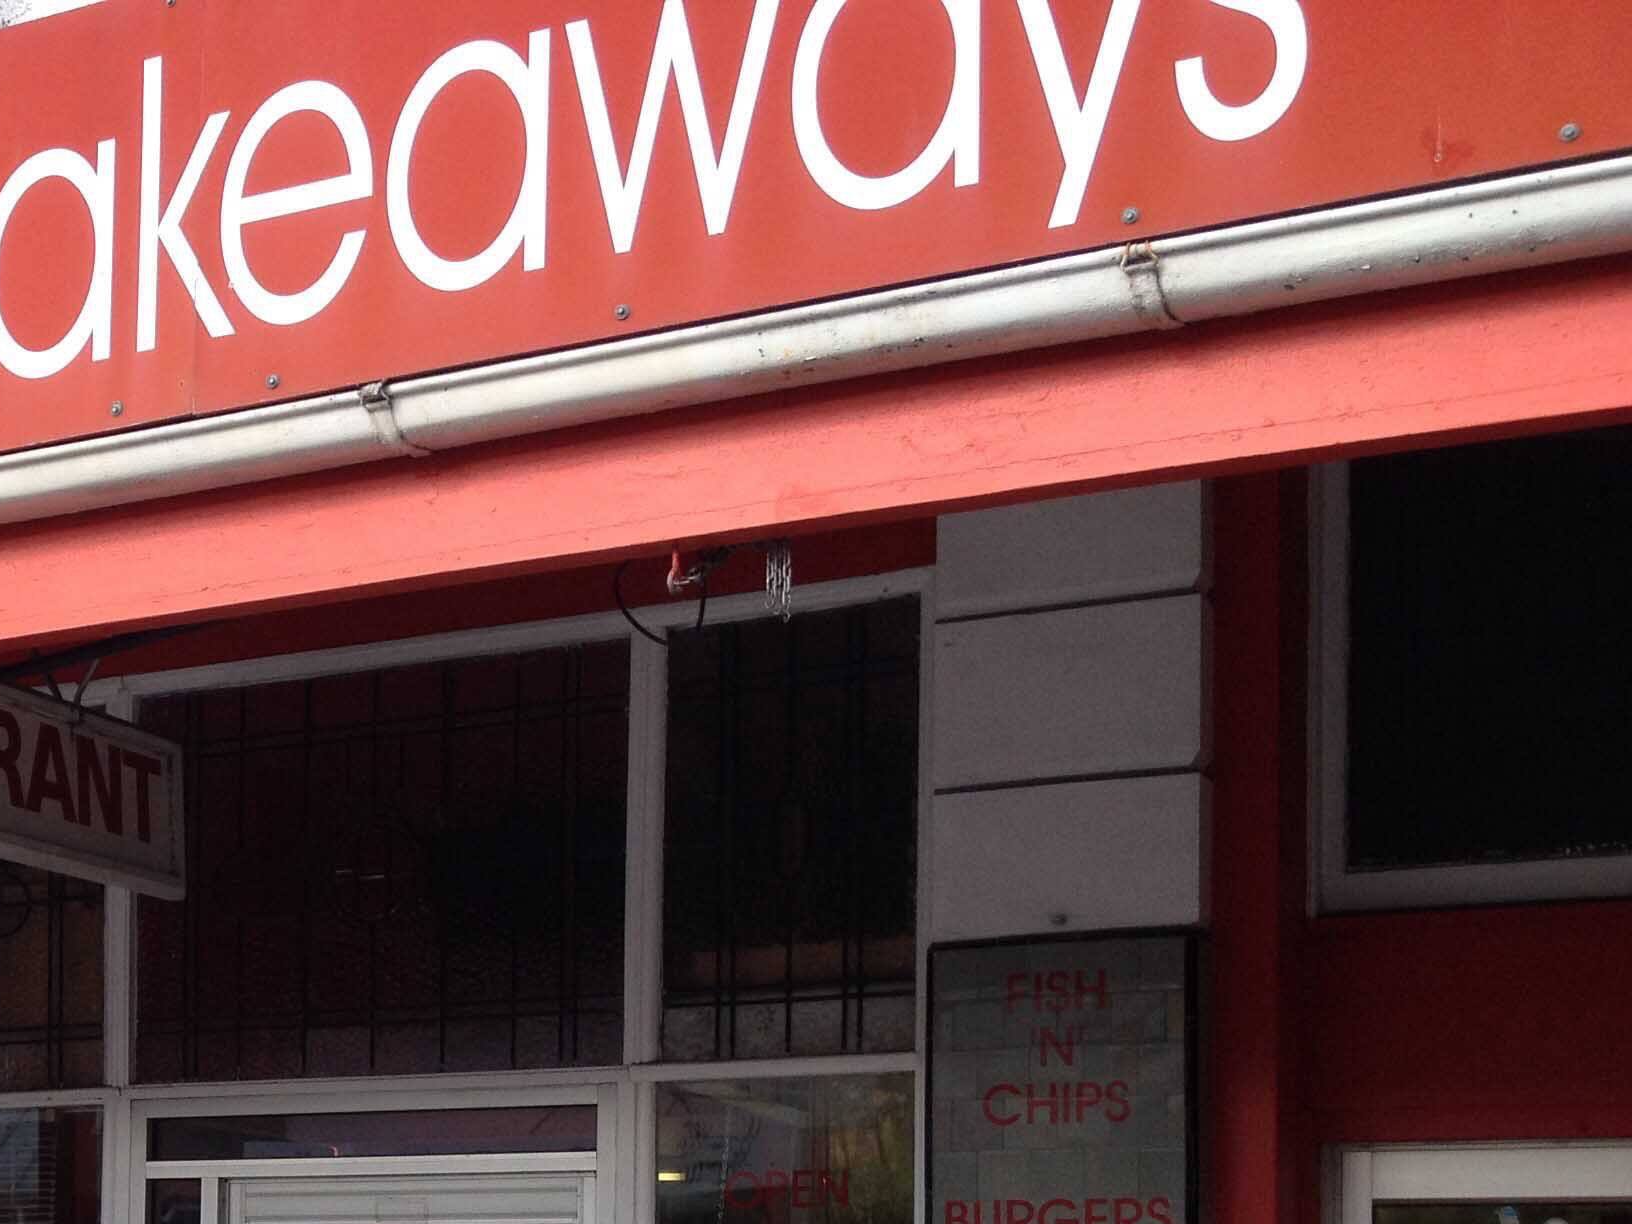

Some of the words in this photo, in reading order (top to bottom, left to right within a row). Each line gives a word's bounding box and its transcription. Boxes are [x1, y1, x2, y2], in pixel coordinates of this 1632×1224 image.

[1006, 968, 1108, 1014] FISH
[981, 1079, 1132, 1126] CHIPS
[725, 1169, 849, 1209] OPEN
